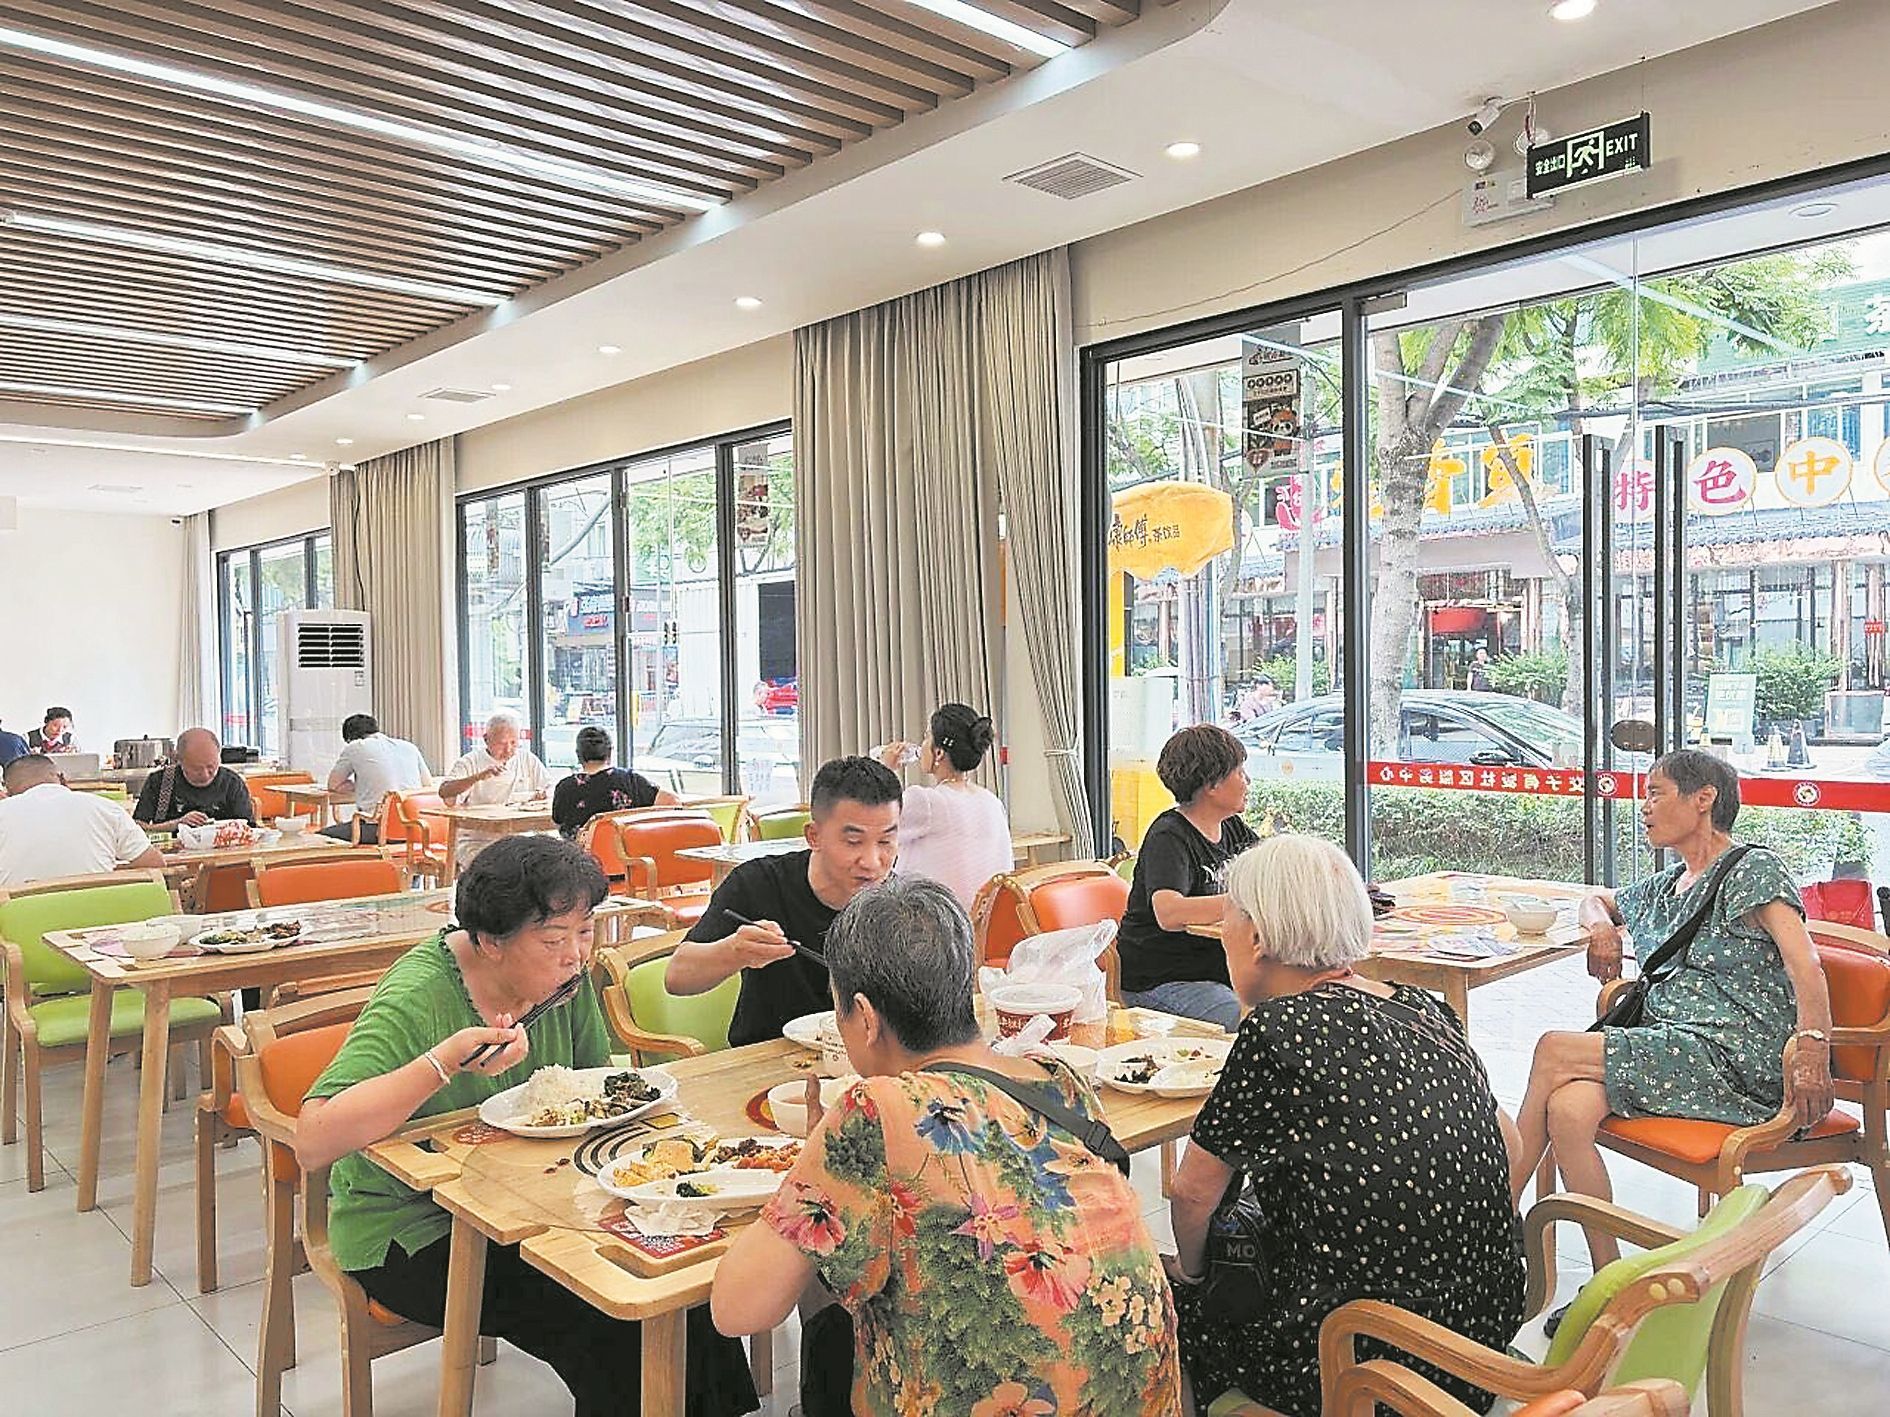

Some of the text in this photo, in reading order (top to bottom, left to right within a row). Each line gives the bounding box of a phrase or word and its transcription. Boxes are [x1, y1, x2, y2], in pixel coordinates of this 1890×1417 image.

[1606, 133, 1638, 156] EXIT
[1535, 155, 1565, 176] 安全出口
[1613, 450, 1890, 511] 特色中
